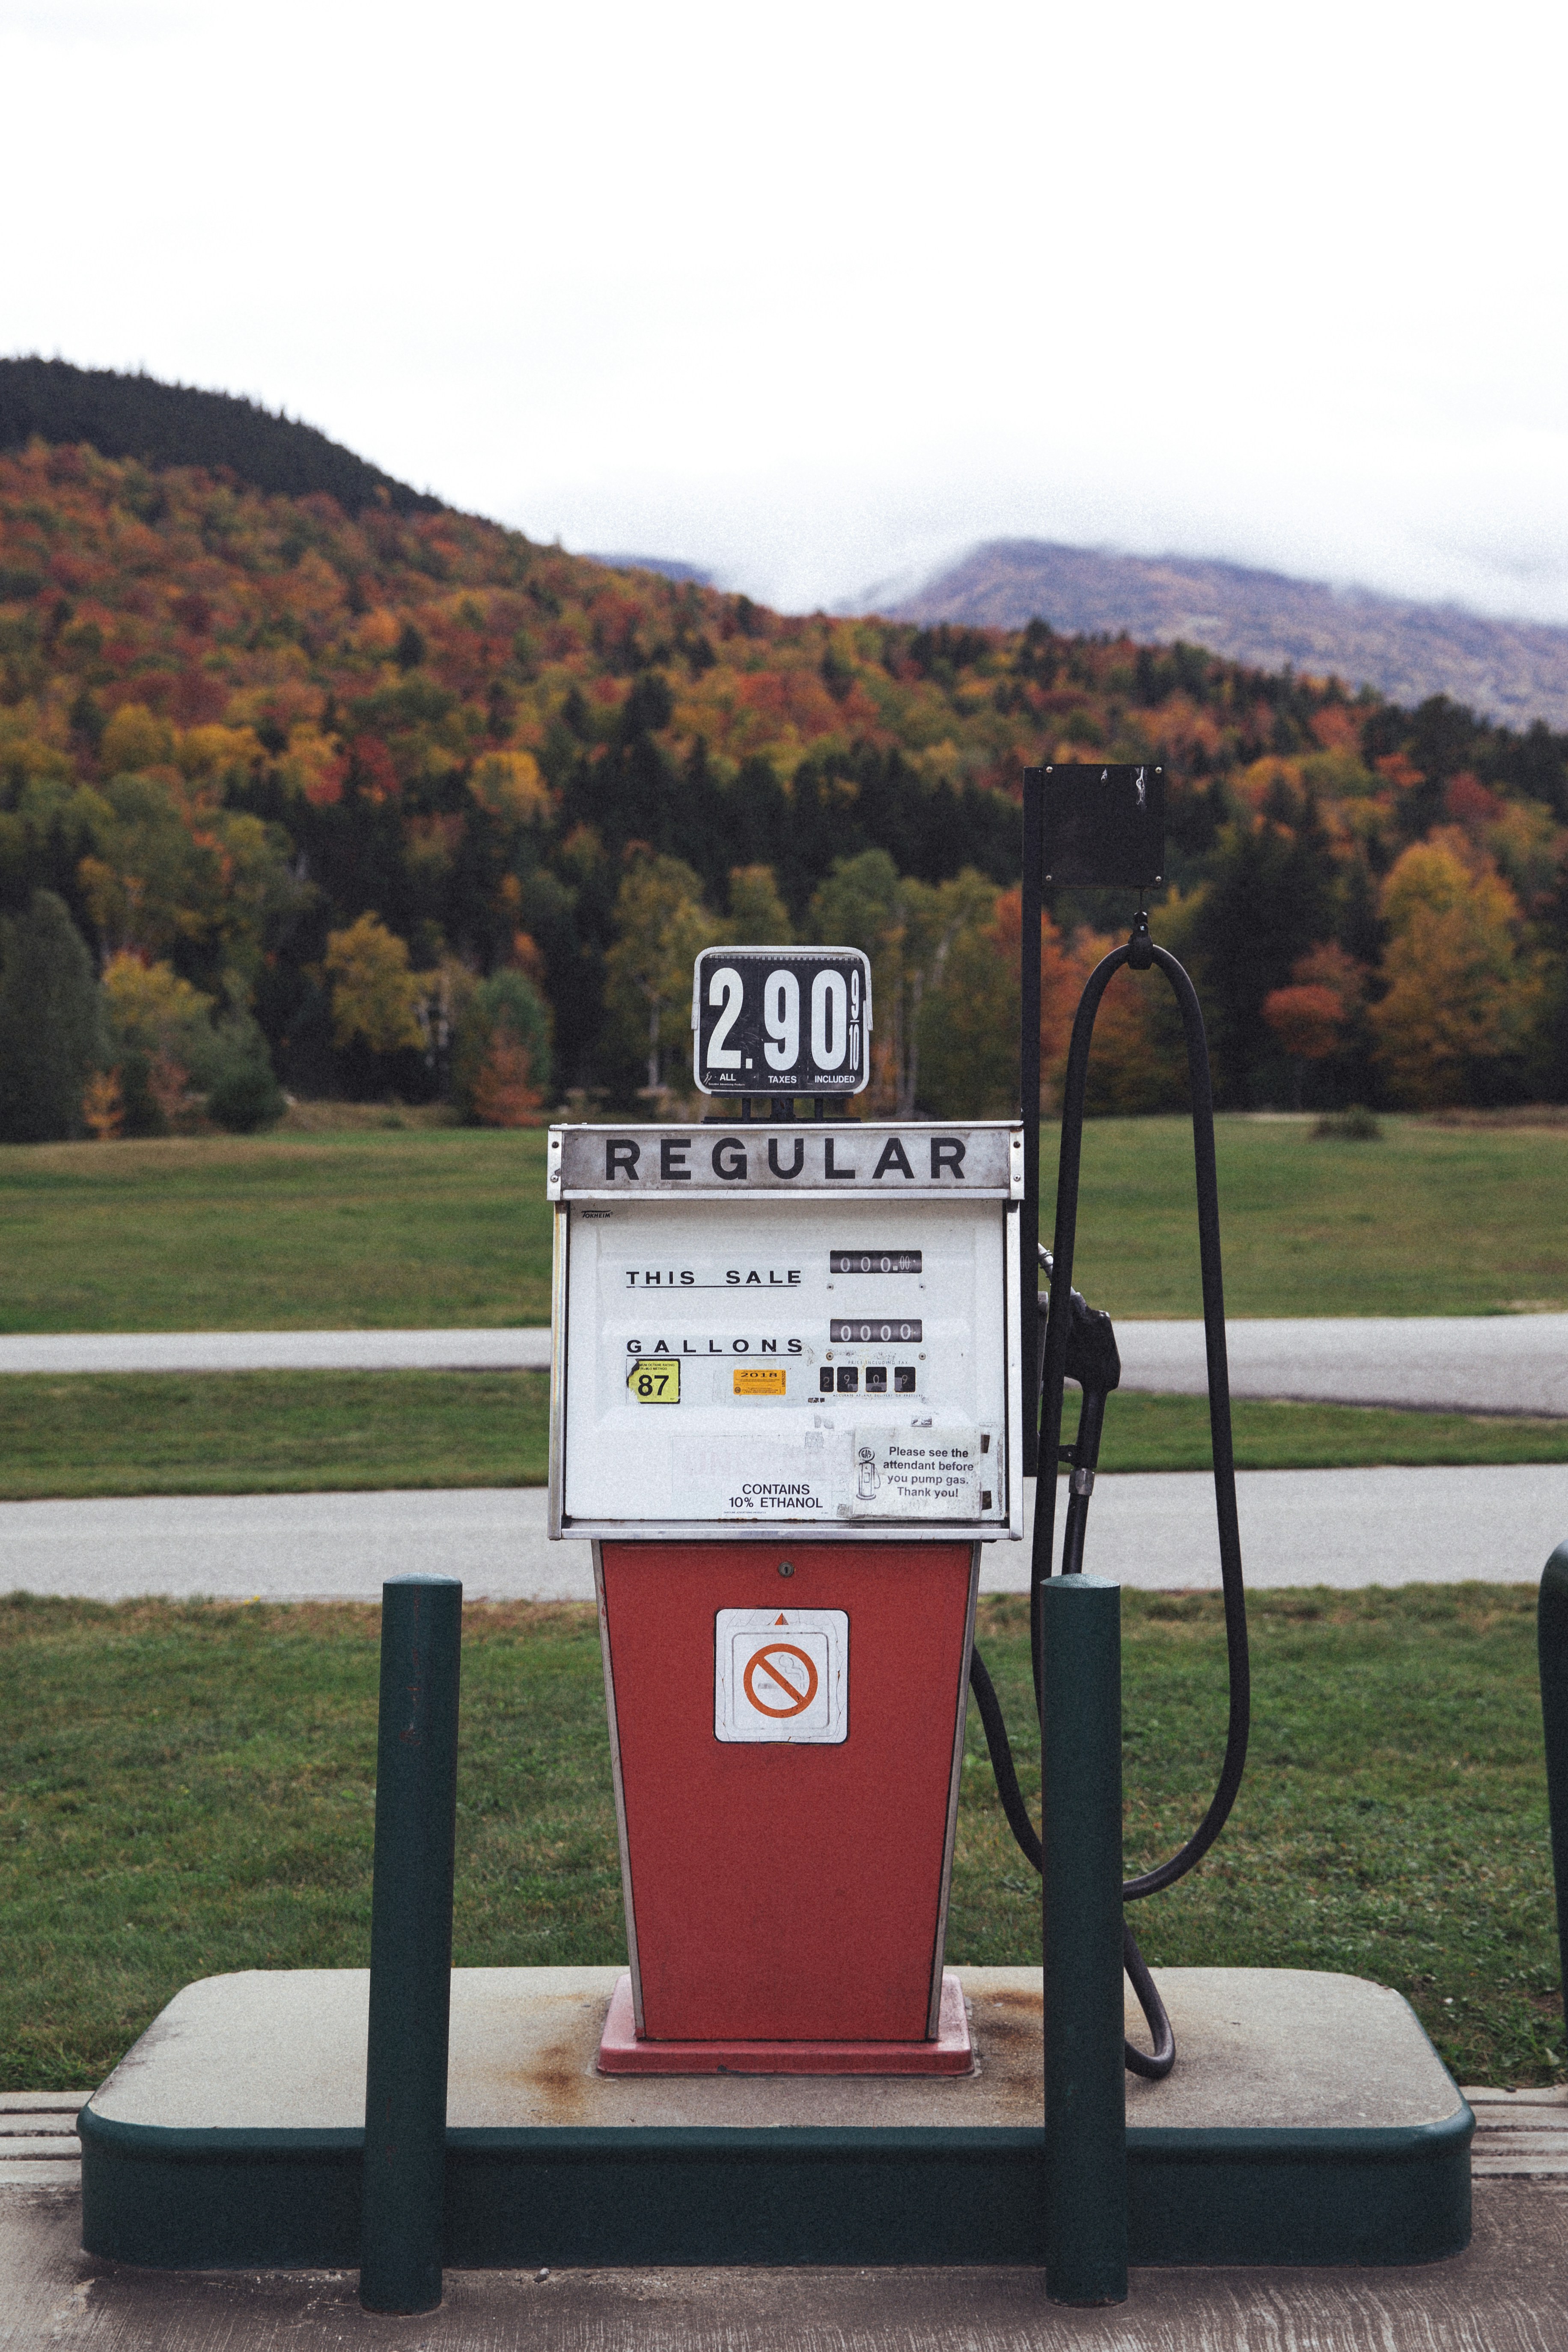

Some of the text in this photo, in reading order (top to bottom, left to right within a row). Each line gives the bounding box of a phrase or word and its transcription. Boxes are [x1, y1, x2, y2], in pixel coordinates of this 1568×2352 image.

[707, 968, 847, 1071] 2.90
[605, 1137, 966, 1180] REGULAR
[581, 1210, 611, 1218] TOKHEIM
[626, 1271, 801, 1284] THIS SALE
[627, 1339, 802, 1353] GALLONS
[638, 1375, 669, 1396] 87
[861, 1449, 872, 1458] GAS
[889, 1447, 925, 1456] Please
[952, 1448, 968, 1458] the
[883, 1461, 974, 1471] attendant before
[887, 1475, 969, 1486] you pump gas.
[742, 1484, 810, 1495] CONTAINS
[897, 1487, 958, 1499] Thank you!
[729, 1497, 823, 1508] 10% ETHANOL
